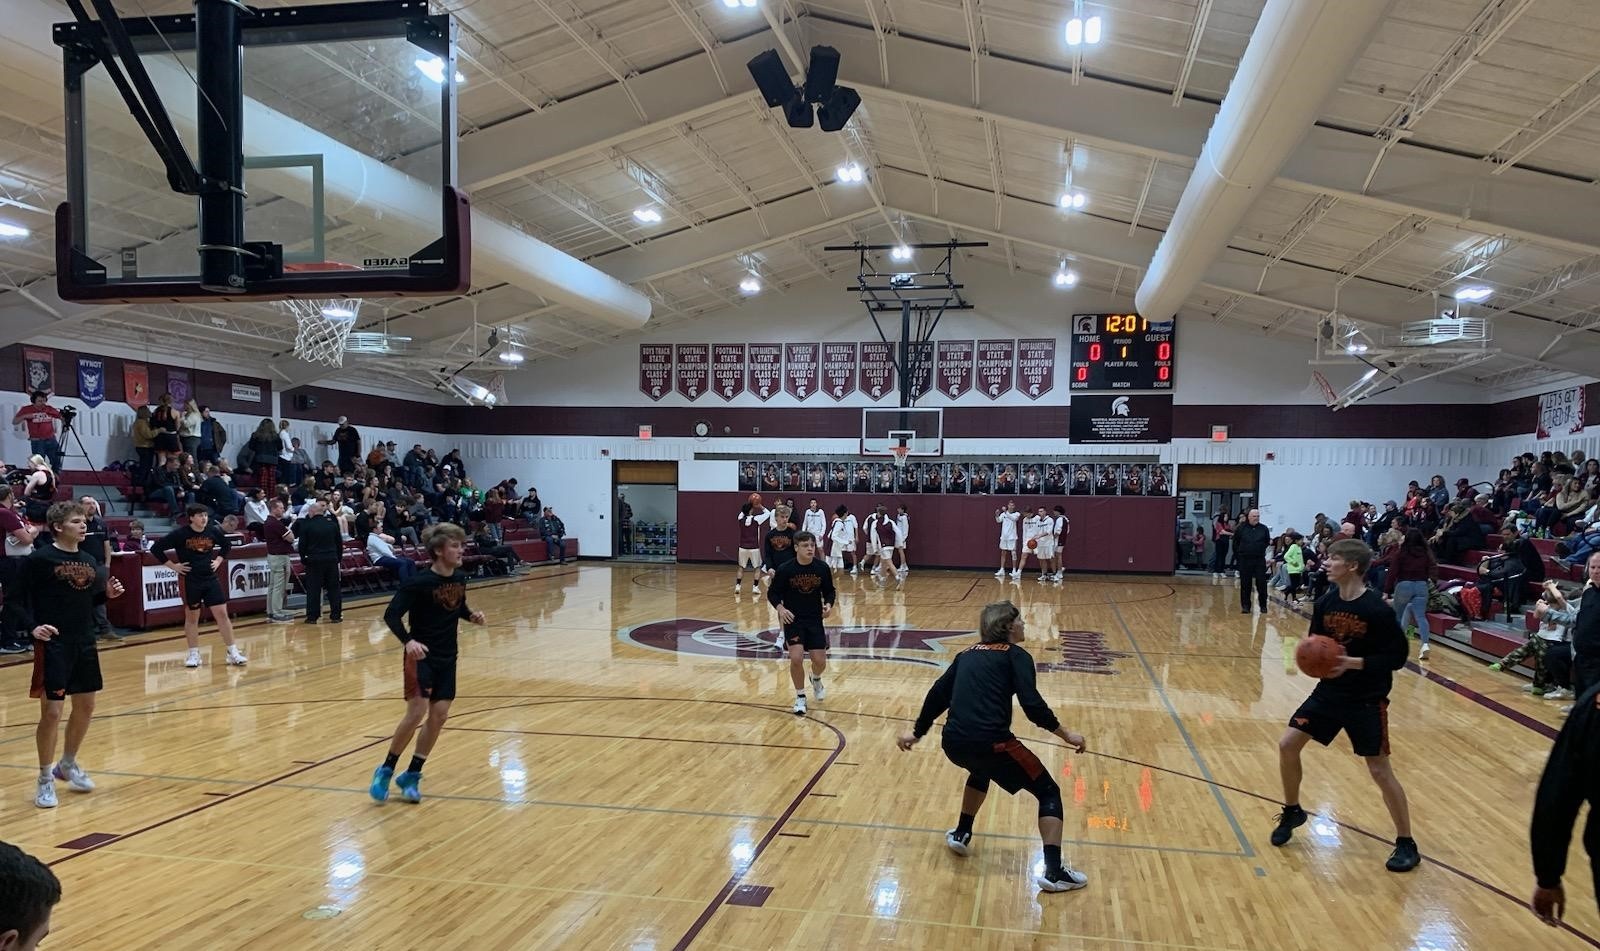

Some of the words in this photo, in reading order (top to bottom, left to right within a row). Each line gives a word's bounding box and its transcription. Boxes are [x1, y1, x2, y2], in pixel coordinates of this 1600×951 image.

[1090, 344, 1100, 360] 0
[1122, 346, 1126, 358] 1
[1159, 343, 1170, 360] 0
[80, 360, 102, 368] WYNOT
[1078, 367, 1086, 380] 0
[1160, 367, 1168, 380] 0
[155, 570, 176, 579] Welco
[248, 571, 270, 590] TROJ
[146, 581, 179, 601] WAKE
